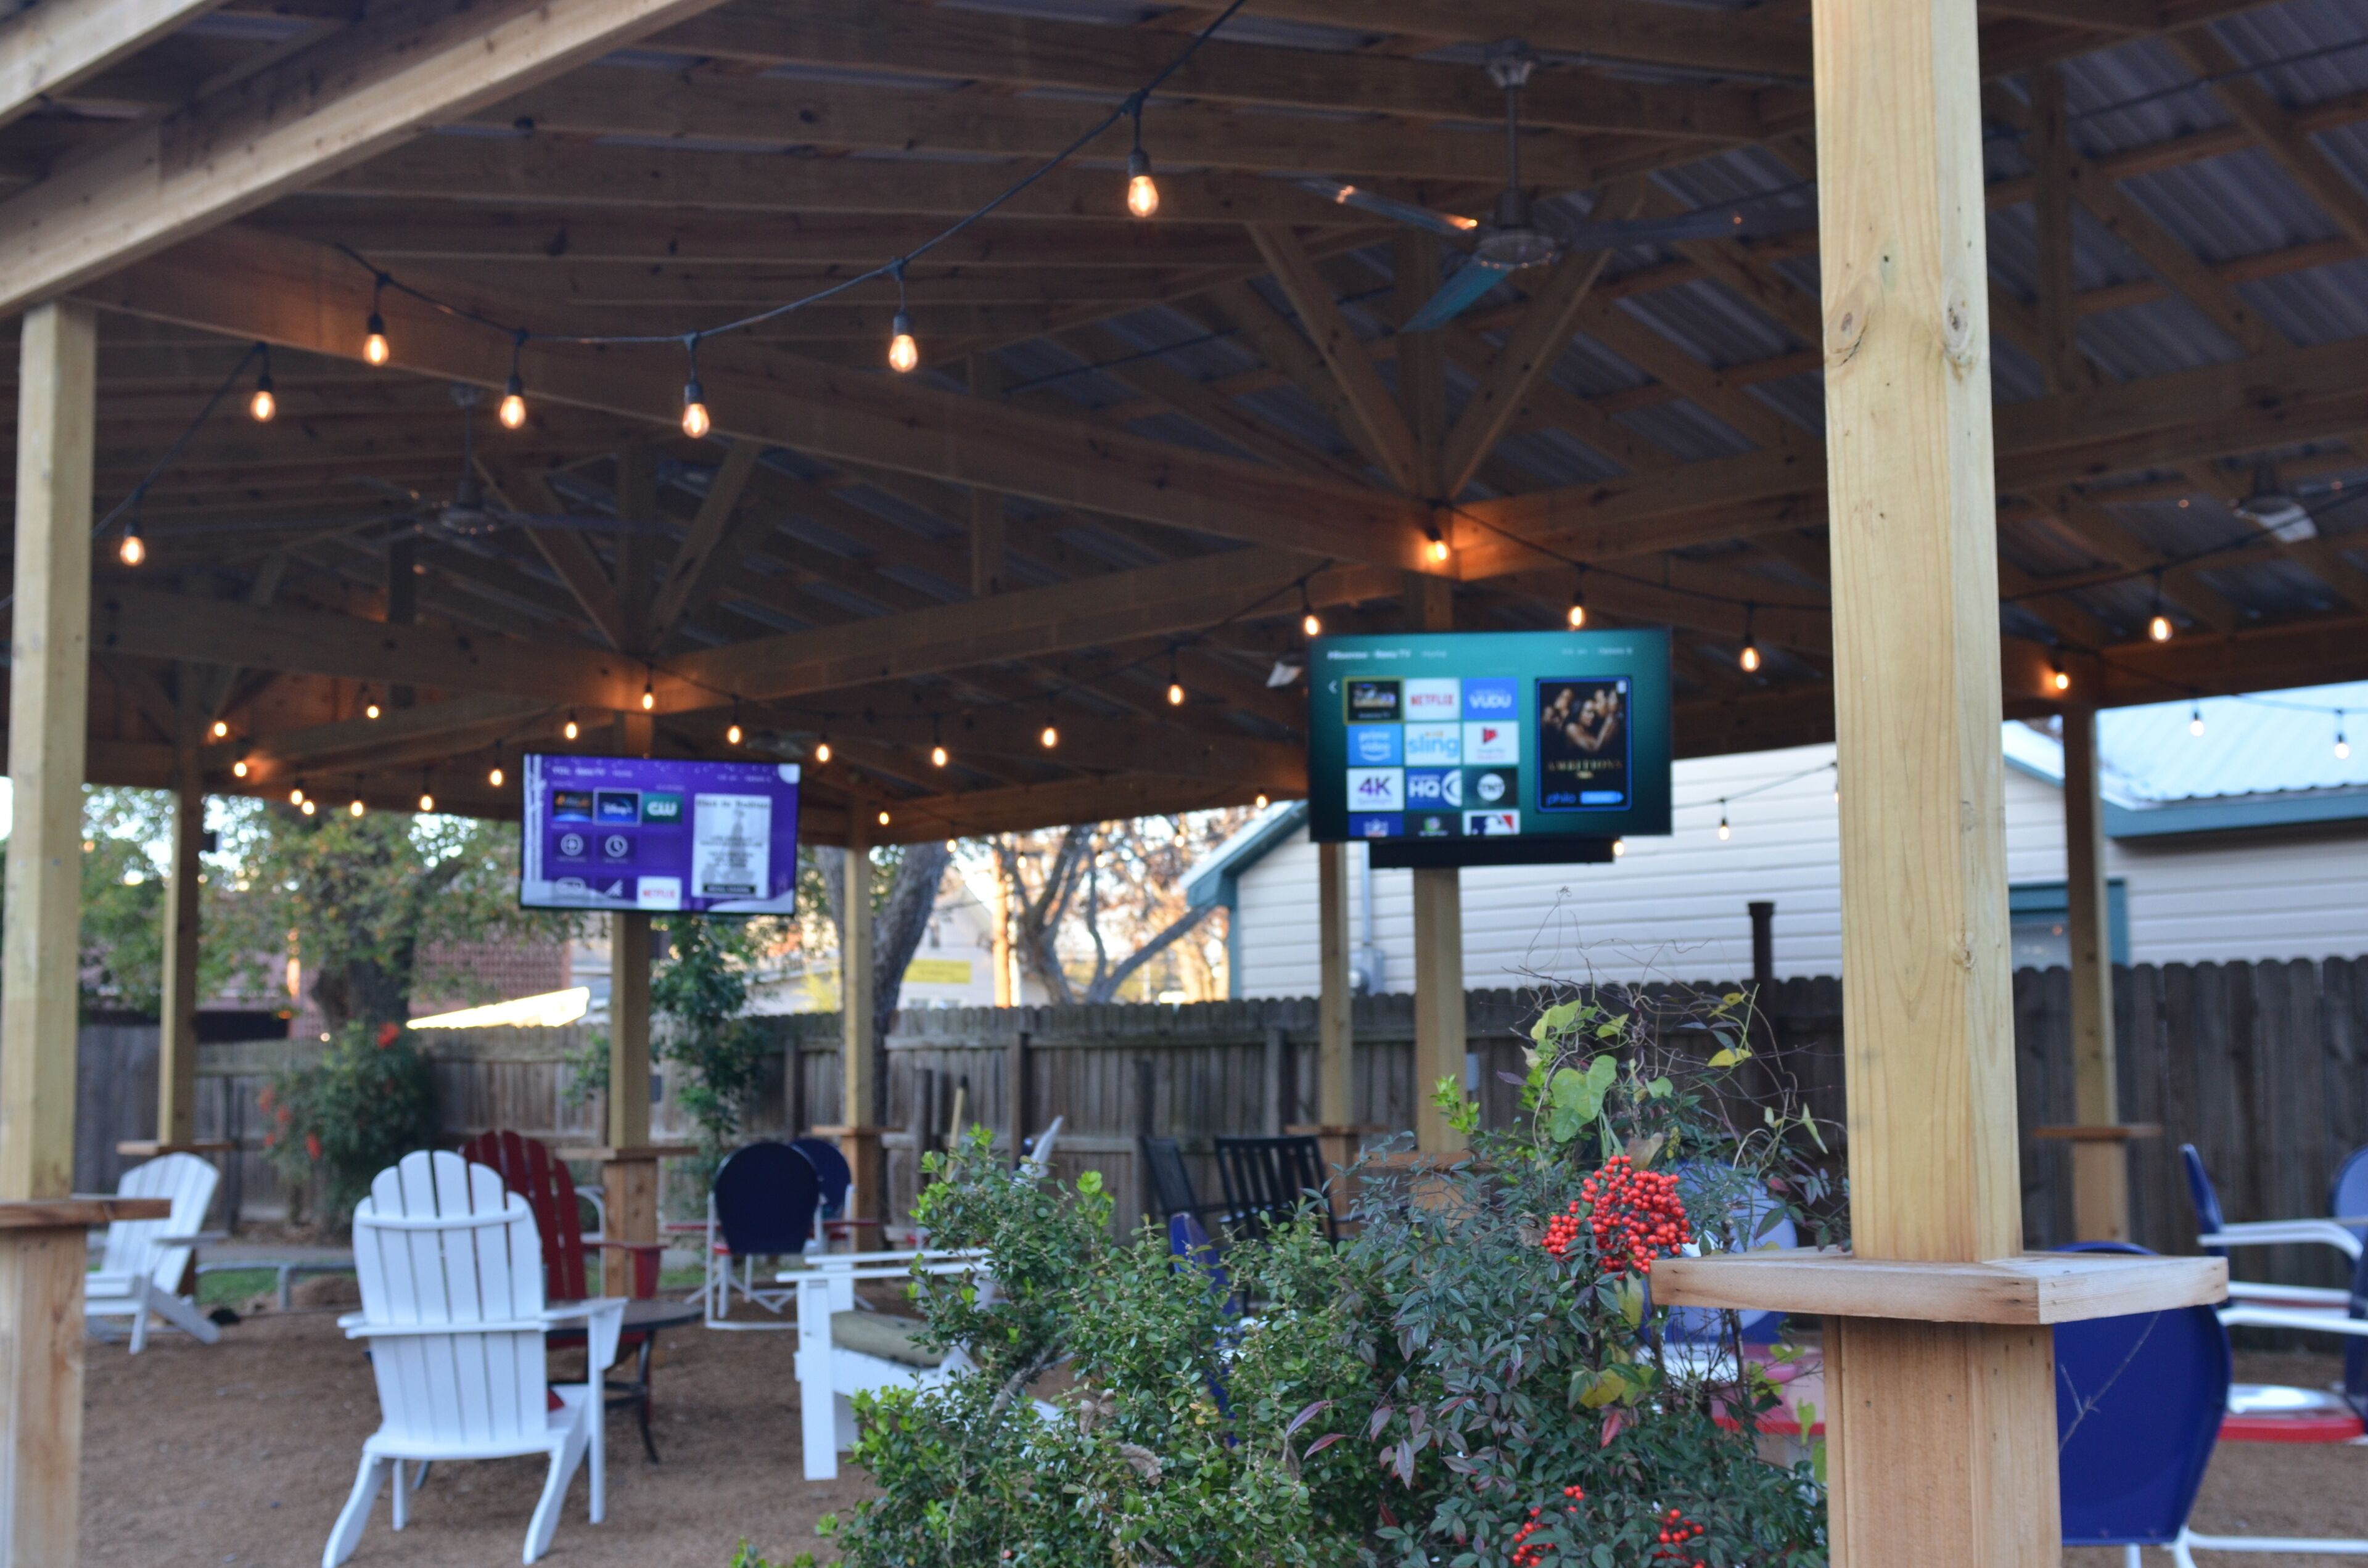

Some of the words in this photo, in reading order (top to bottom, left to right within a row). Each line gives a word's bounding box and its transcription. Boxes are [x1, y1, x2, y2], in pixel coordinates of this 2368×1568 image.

[1410, 694, 1453, 706] NETFLIX
[1408, 734, 1459, 758] sling
[1359, 776, 1391, 796] 4K
[1409, 781, 1441, 798] HQ
